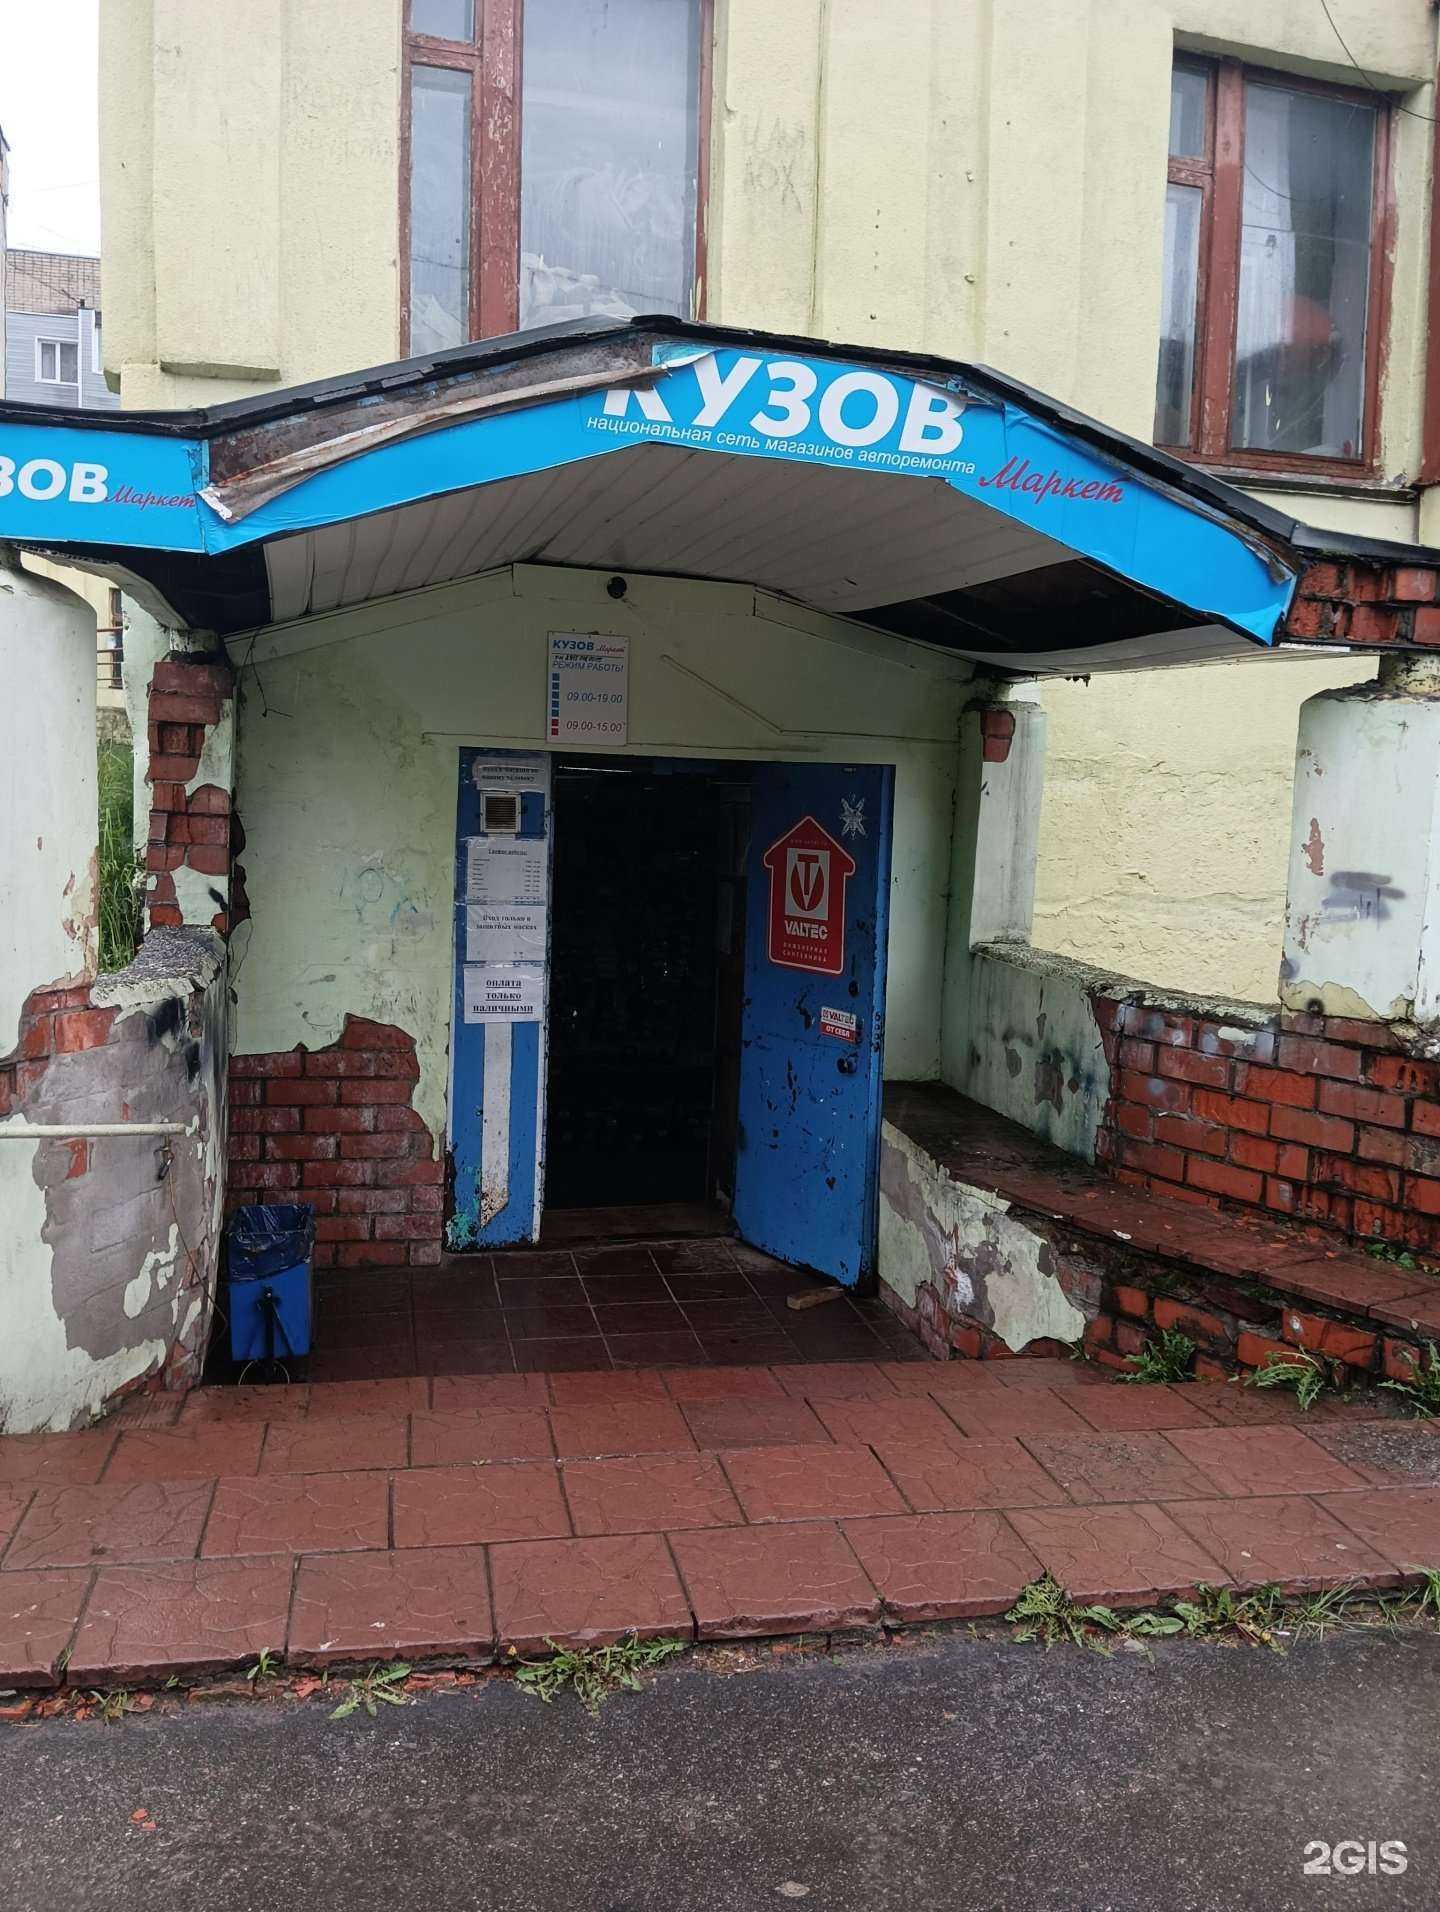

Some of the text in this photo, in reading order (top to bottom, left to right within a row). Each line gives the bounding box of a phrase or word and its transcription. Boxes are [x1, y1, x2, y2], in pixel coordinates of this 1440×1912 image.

[587, 416, 976, 475] национальная сеть магазинов авторемонта
[978, 455, 1131, 505] Маркет
[105, 484, 197, 511] Маркет
[552, 640, 594, 651] КУЗОВ
[553, 661, 624, 673] РЕЖИМ РАБОТЫ
[784, 920, 829, 940] VALTEC
